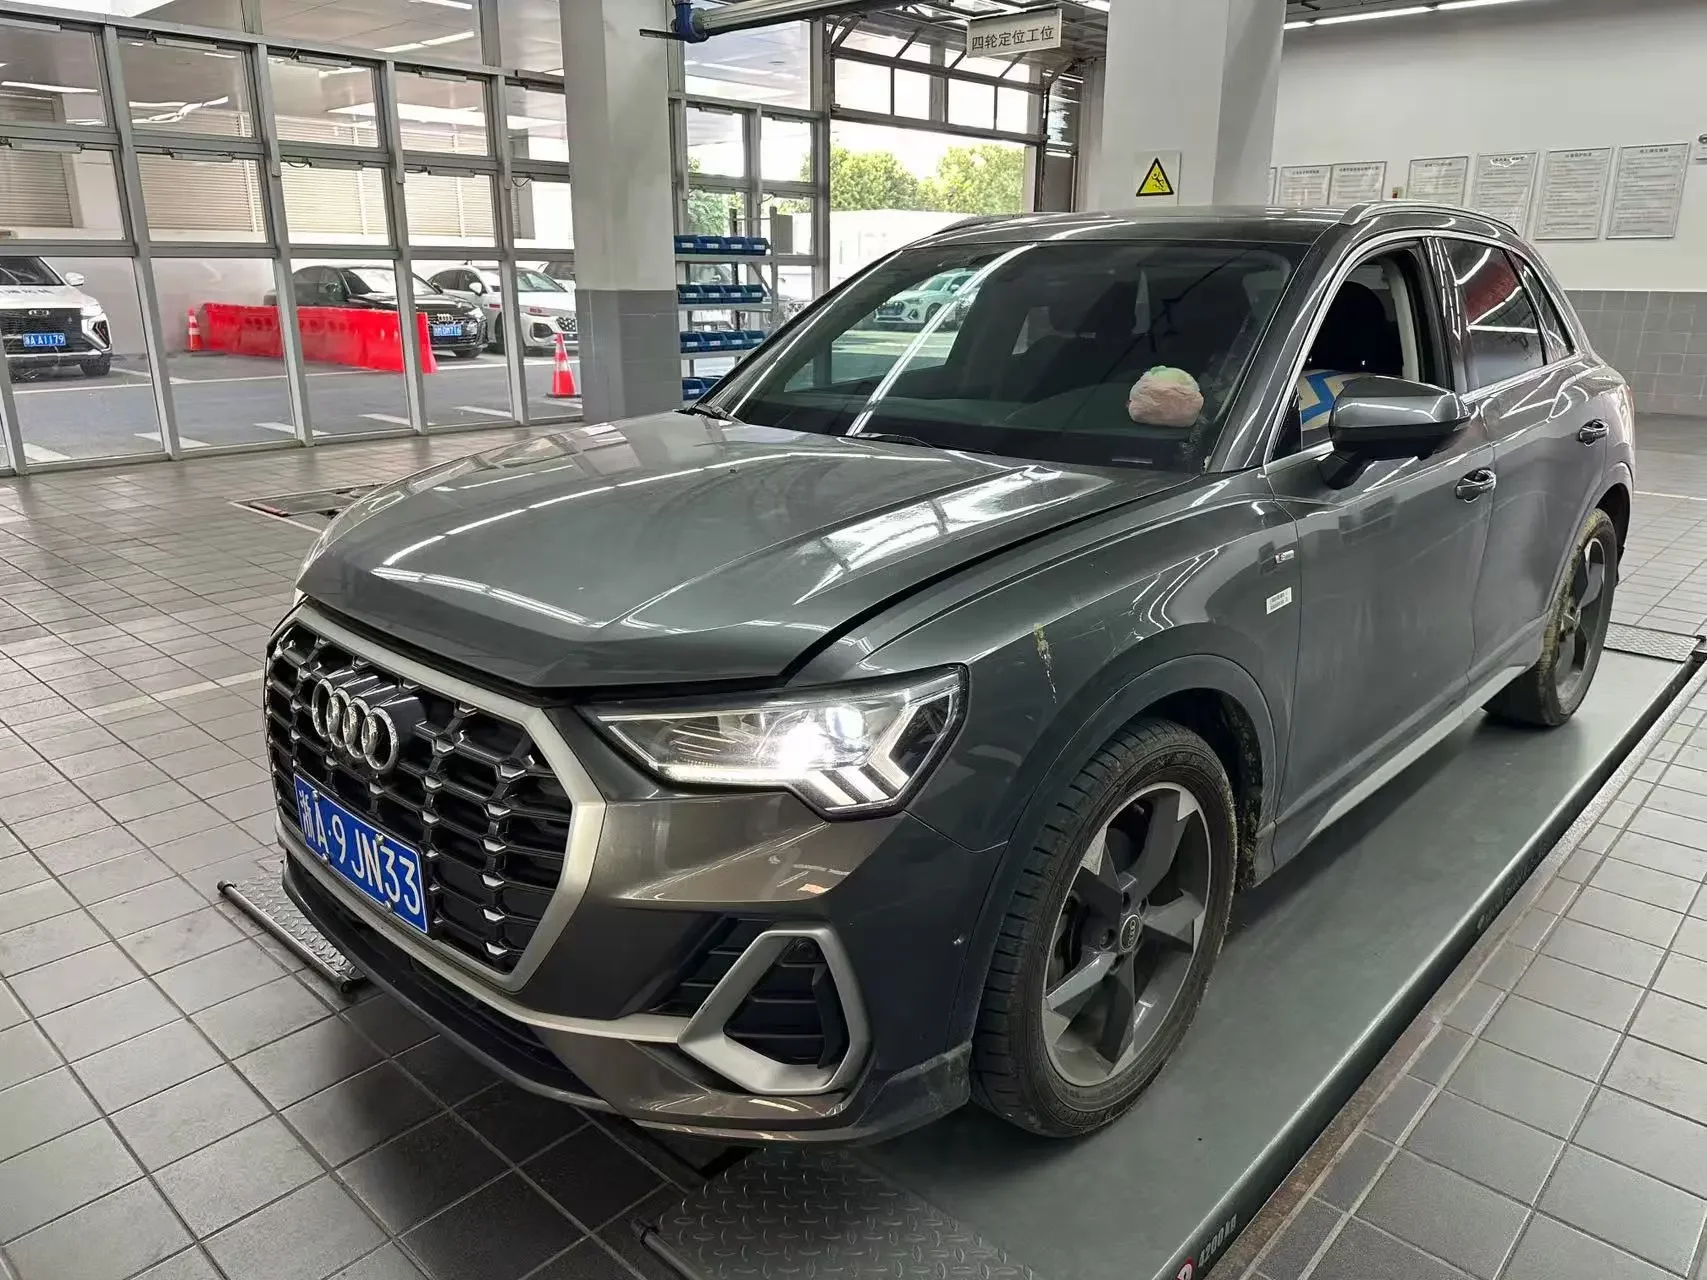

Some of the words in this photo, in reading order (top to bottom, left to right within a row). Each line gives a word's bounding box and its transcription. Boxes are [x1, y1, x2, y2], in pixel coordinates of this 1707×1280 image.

[972, 25, 1054, 51] 四轮定位工位
